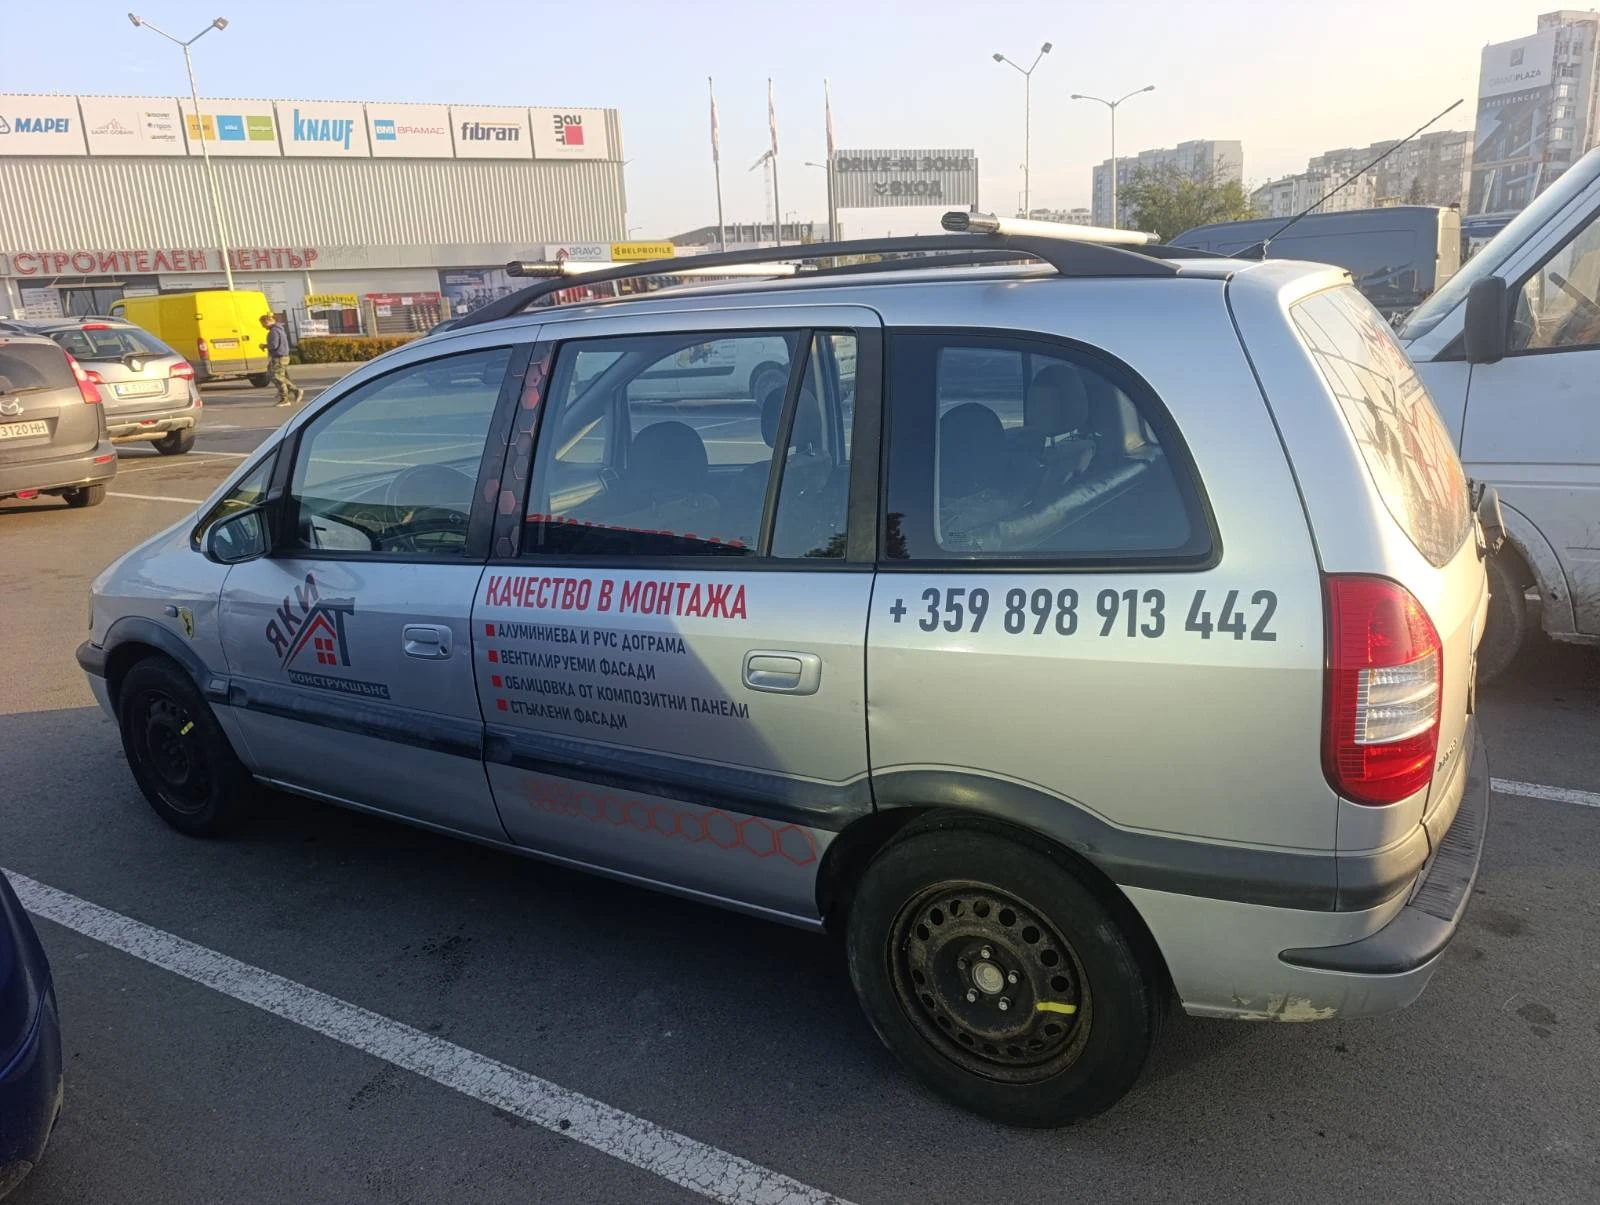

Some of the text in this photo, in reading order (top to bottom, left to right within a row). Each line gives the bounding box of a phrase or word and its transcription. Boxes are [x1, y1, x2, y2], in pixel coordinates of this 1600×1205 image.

[15, 117, 70, 133] MAPEI
[293, 109, 354, 149] KNAUF
[397, 126, 445, 135] BRAMAC
[461, 122, 520, 141] fibran
[13, 247, 319, 275] СТРОИТЕЛЕН ЦЕНТЪР
[569, 246, 602, 256] BRAVO
[621, 246, 672, 255] BELPROFILE
[0, 424, 28, 437] 3120
[485, 575, 748, 620] КАЧЕСТВО В МОНТАЖА
[918, 587, 990, 634] 359
[1003, 588, 1079, 636] 898
[1095, 588, 1166, 639] 913
[1184, 589, 1279, 642] 442
[498, 623, 578, 645] АЛУМИНИЕВА
[580, 629, 590, 646] И
[621, 633, 687, 655] ДОГРАМА
[501, 650, 657, 681] ВЕНТИЛИРУЕМИ ФАСАДИ
[504, 675, 751, 720] ОБЛИЦОВКА ОТ КОМПОЗИТНИ ПАНЕЛИ
[510, 700, 629, 730] СТЪКЛЕНИ ФАСАДИ
